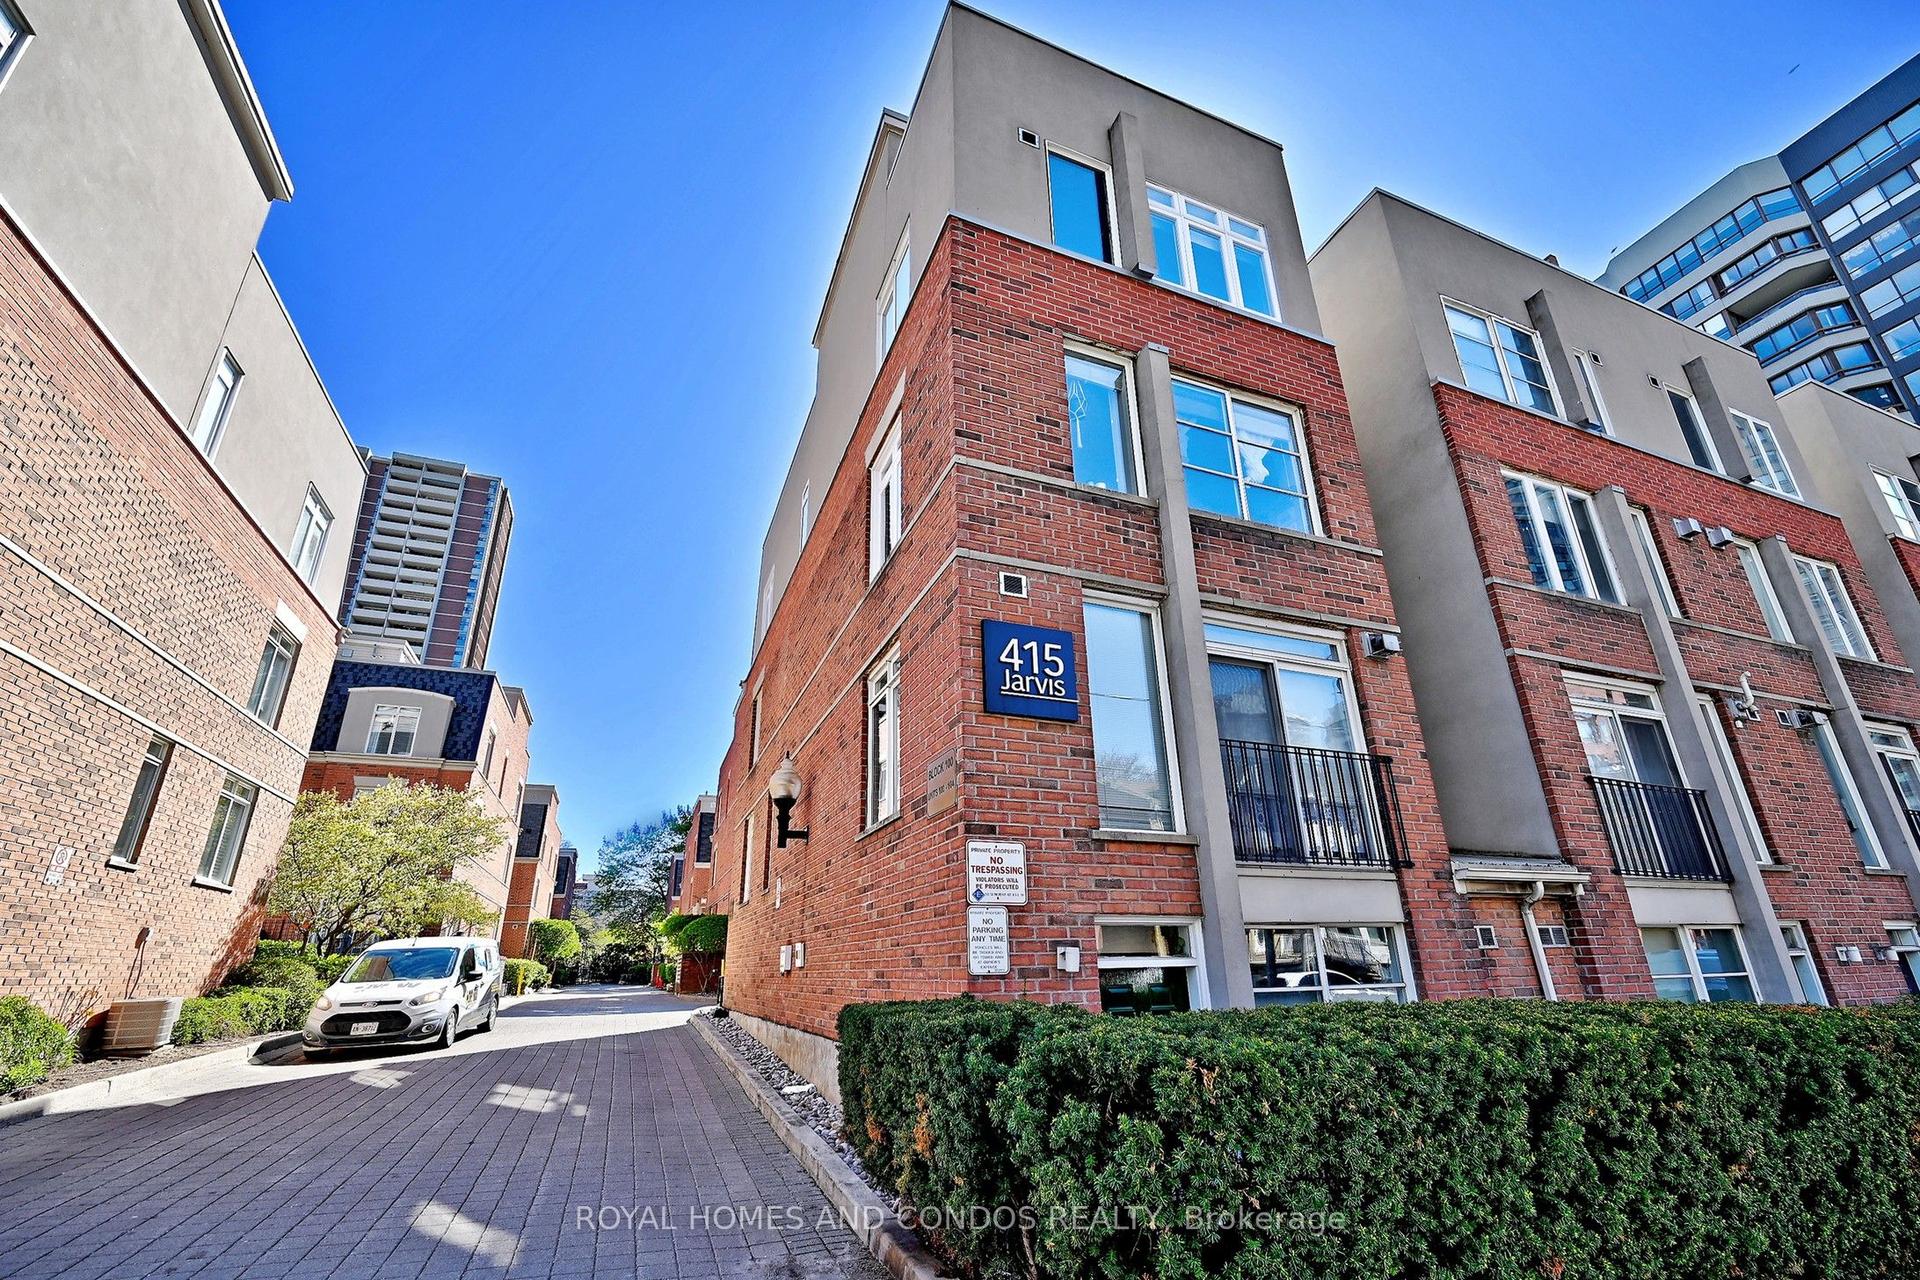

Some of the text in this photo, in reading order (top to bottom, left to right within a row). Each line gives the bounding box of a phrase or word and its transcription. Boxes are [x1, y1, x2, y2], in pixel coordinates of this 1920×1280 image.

[999, 638, 1064, 677] 415
[1000, 668, 1066, 697] Jarvis
[990, 856, 1004, 865] NO
[971, 865, 1023, 875] TRESPASSING
[972, 926, 1004, 934] PARKING
[989, 935, 1006, 943] TIME
